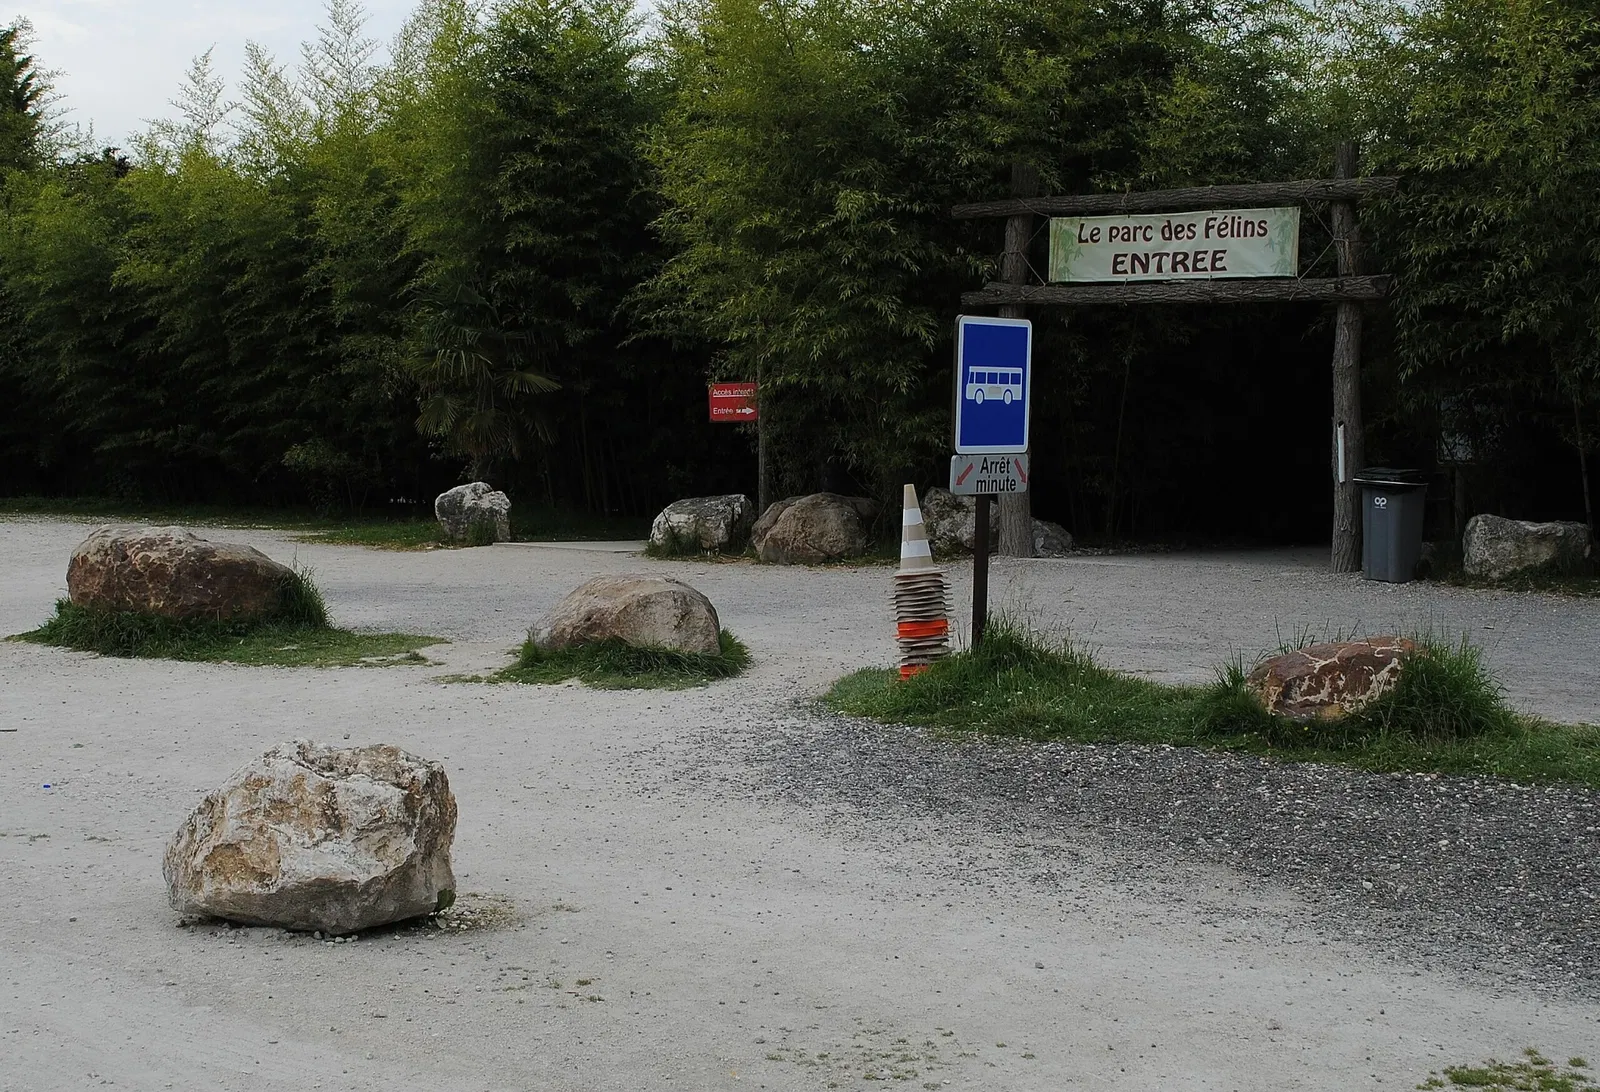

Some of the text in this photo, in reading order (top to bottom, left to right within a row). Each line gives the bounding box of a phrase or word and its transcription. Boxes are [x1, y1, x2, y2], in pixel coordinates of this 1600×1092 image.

[1077, 215, 1269, 244] Le parc des Félins
[1111, 250, 1228, 275] ENTREE
[980, 456, 1011, 474] Arrêt
[976, 475, 1017, 493] minute
